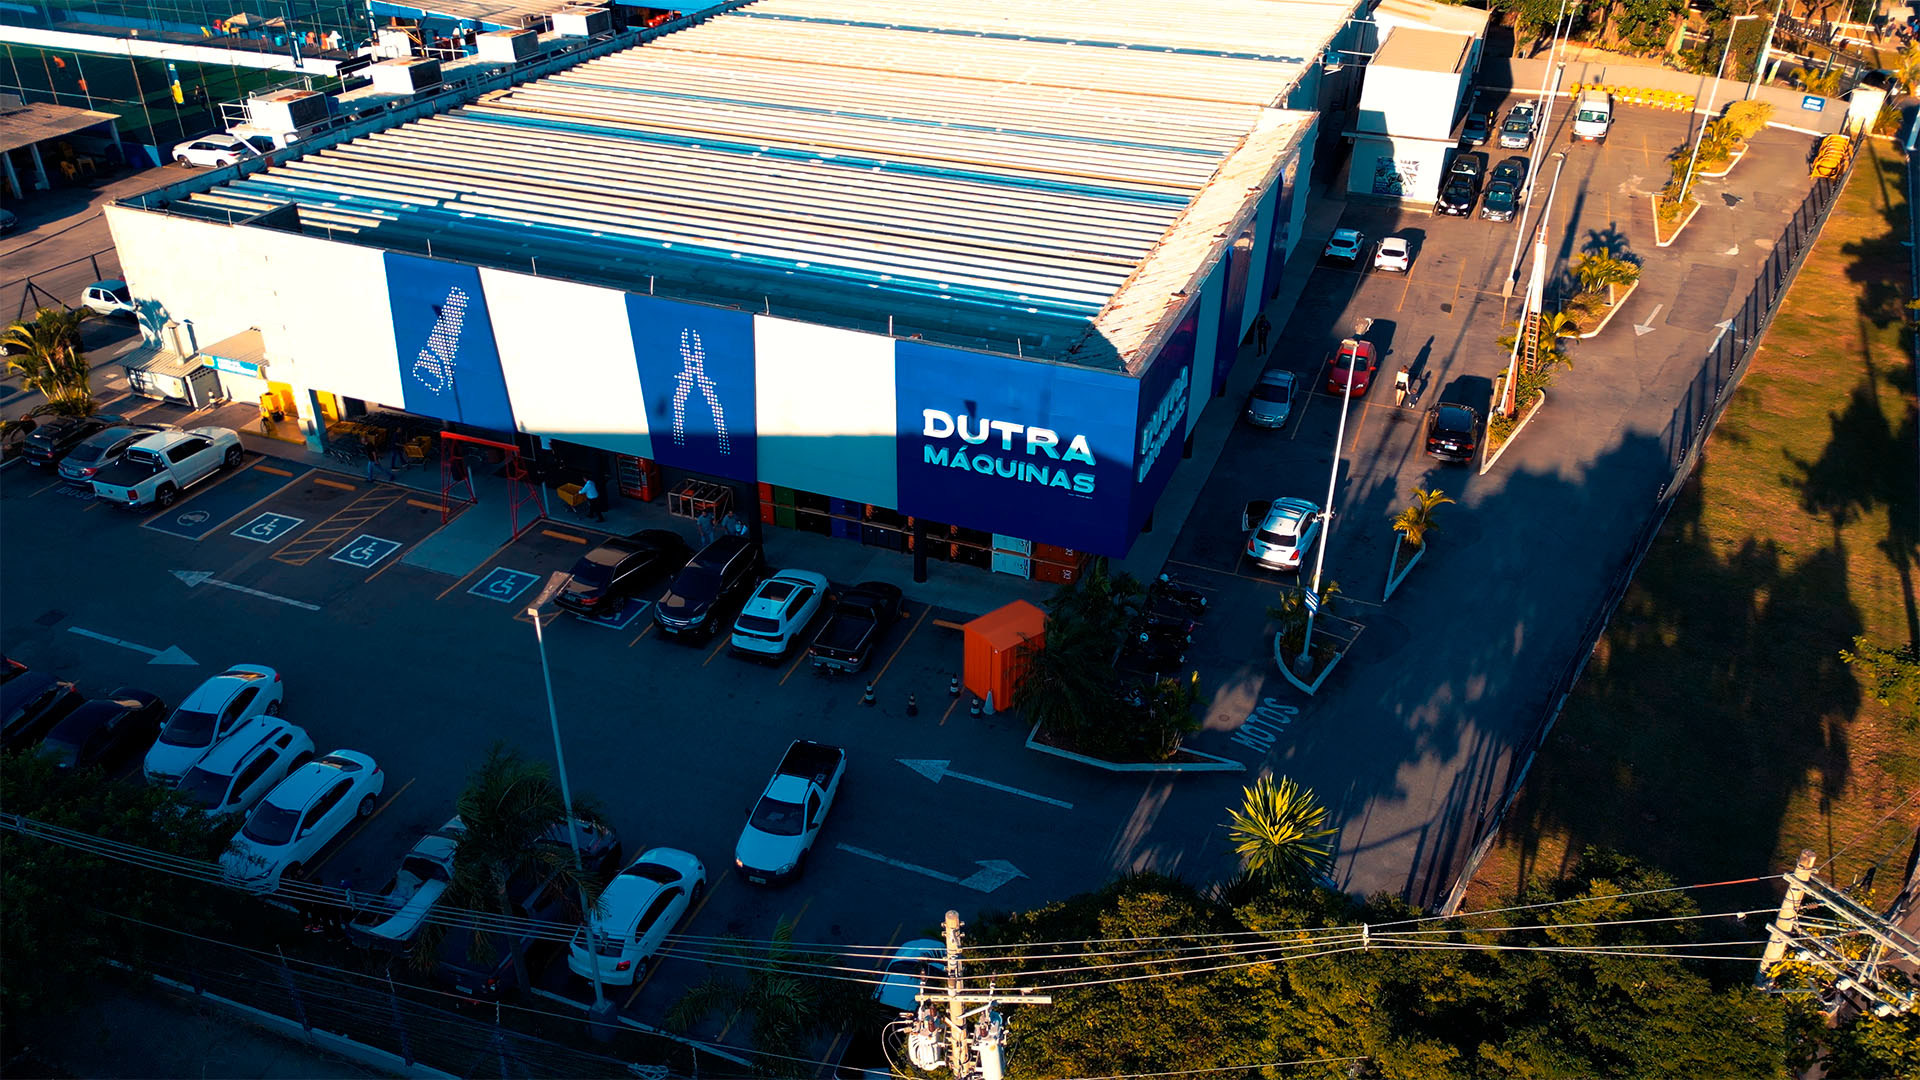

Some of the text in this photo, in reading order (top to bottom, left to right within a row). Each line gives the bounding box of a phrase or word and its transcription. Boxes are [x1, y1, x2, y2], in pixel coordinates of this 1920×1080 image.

[923, 409, 1097, 466] DUTRA
[924, 444, 1096, 494] MÁQUINAS
[1230, 697, 1299, 753] MOTOS
